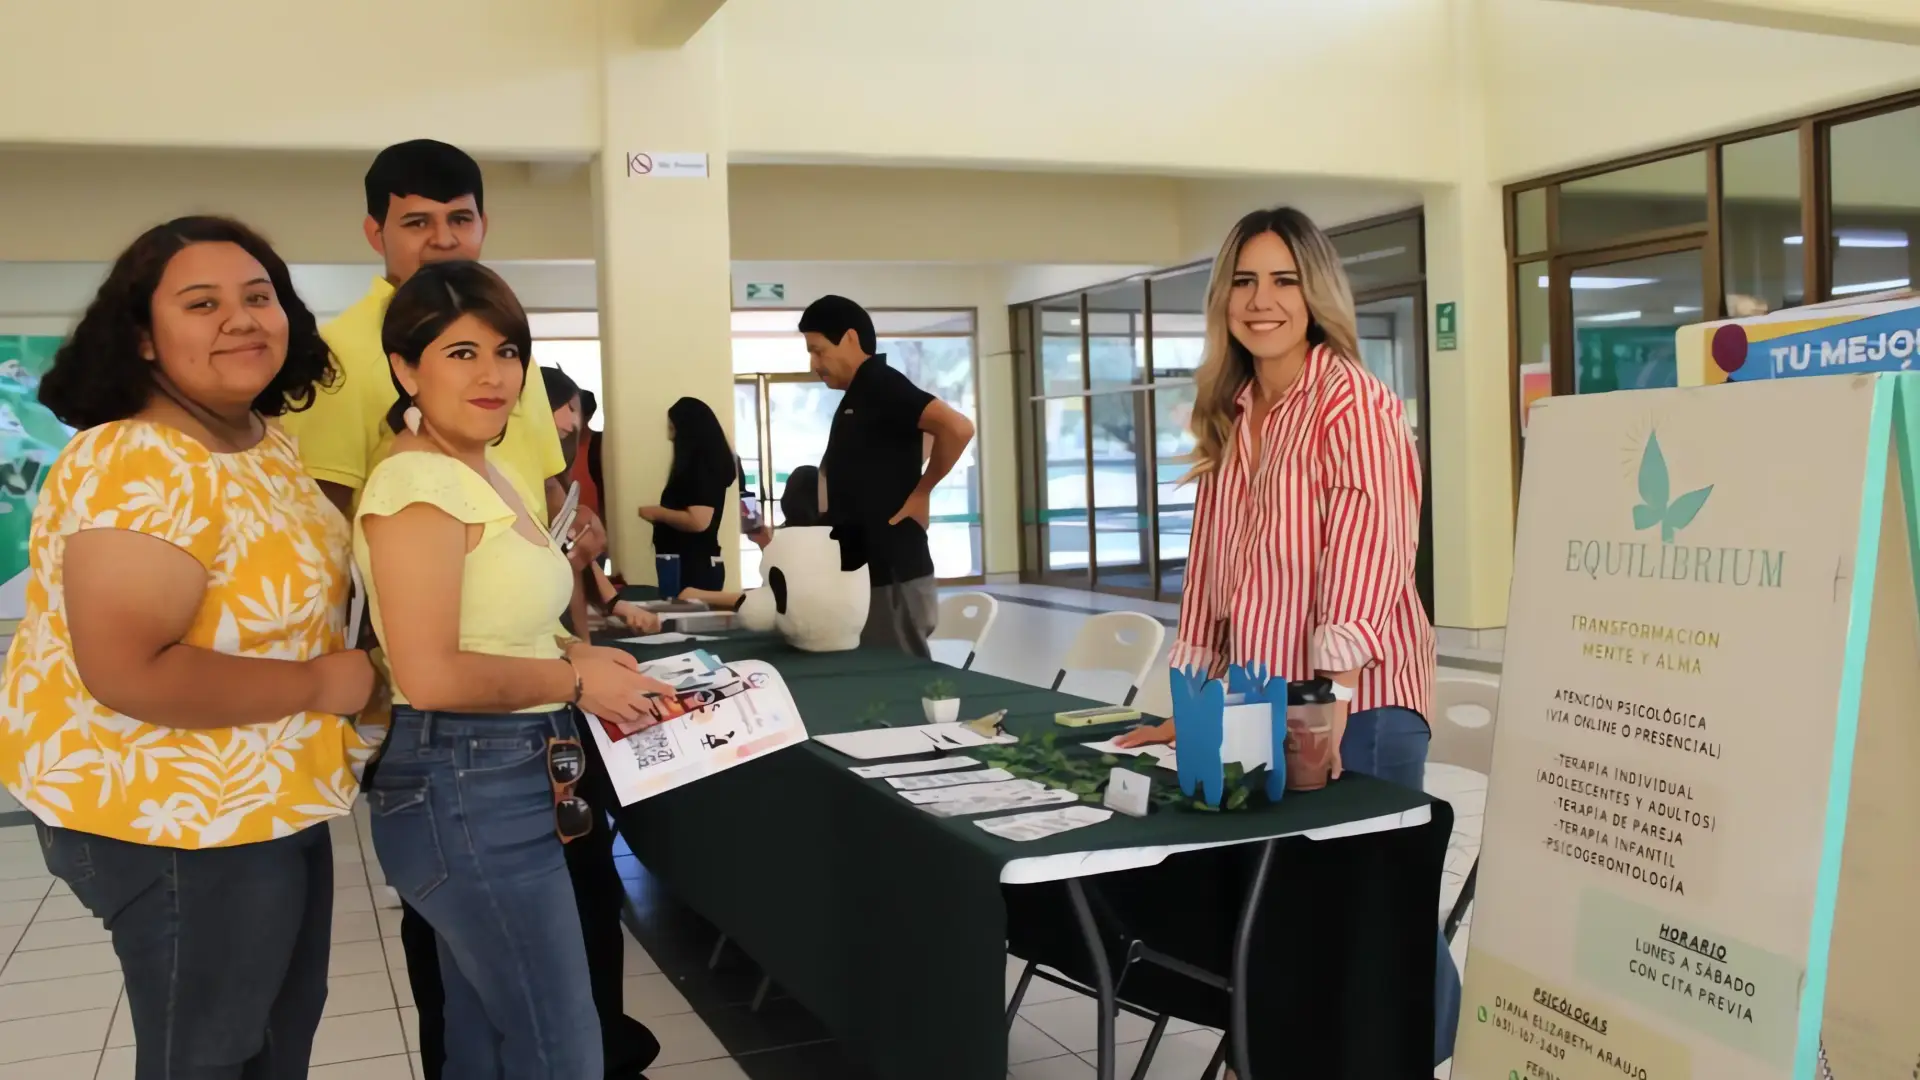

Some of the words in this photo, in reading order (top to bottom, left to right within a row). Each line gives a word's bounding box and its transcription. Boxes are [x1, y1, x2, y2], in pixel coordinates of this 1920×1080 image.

[1770, 343, 1811, 374] TU
[1820, 328, 1920, 368] MEJO
[1565, 539, 1787, 588] EQUILIBRIUM
[1583, 643, 1634, 664] MENTE
[1641, 651, 1651, 666] Y
[1656, 653, 1703, 675] ALMA
[1554, 689, 1613, 711] ATENCIÓN
[1617, 701, 1707, 730] PSICOLÓGICA
[1574, 714, 1617, 735] ONLINE
[1621, 724, 1631, 738] O
[1634, 727, 1721, 760] PRESENCIAL)
[1536, 769, 1630, 807] (ADOLESCENTES
[1636, 796, 1643, 810] Y
[1648, 800, 1716, 832] ADULTOS)
[1614, 767, 1694, 800] INDIVIDUAL
[1554, 819, 1609, 846] -TERAPIA
[1615, 836, 1675, 868] INFANTIL
[1612, 813, 1628, 829] DE
[1632, 819, 1683, 846] PAREJA
[1659, 923, 1728, 962] HORARIO
[1635, 938, 1675, 965] LUNES
[1680, 956, 1690, 972] A
[1695, 962, 1756, 997] SÁBADO
[1533, 987, 1609, 1034] PSICÓLOGAS
[1629, 959, 1657, 982] CON
[1662, 973, 1693, 998] CITA
[1698, 987, 1753, 1024] PREVIA
[1495, 996, 1529, 1021] DIANA
[1532, 1014, 1594, 1055] ELIZABETH
[1596, 1048, 1648, 1080] ARAUJO
